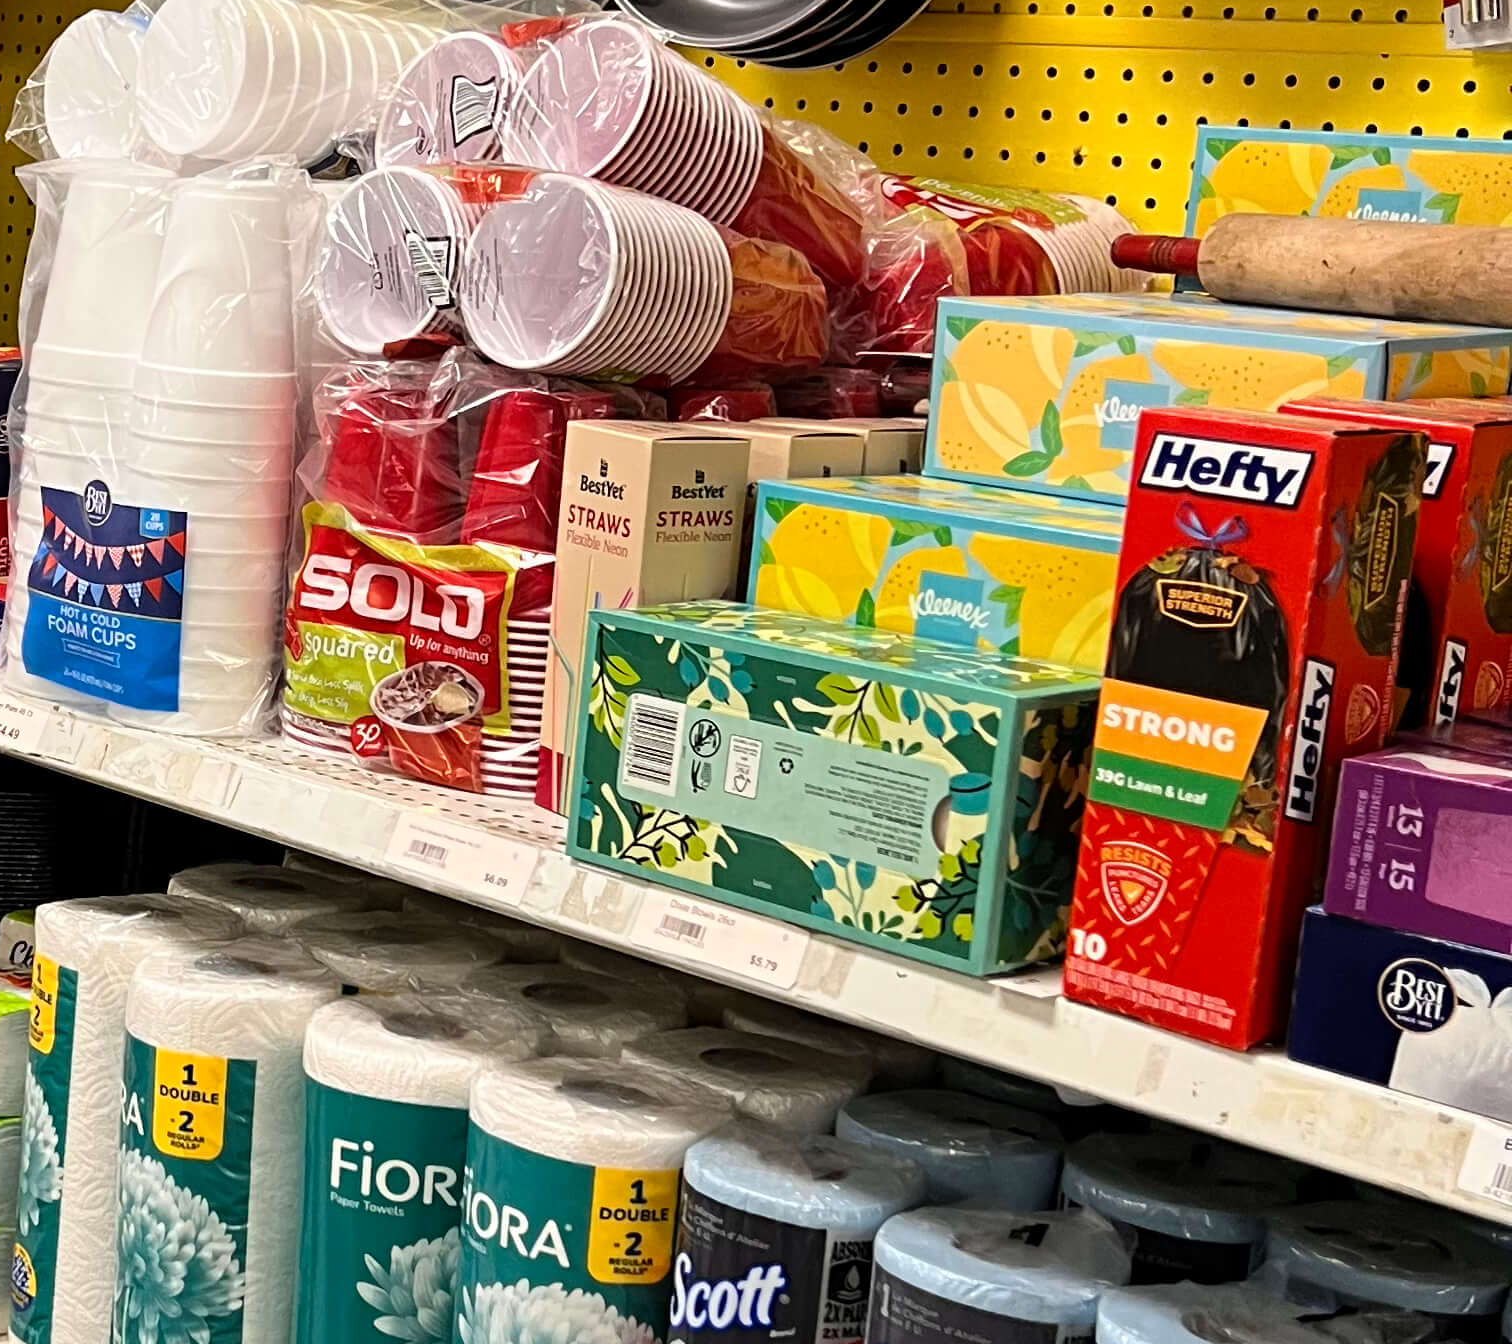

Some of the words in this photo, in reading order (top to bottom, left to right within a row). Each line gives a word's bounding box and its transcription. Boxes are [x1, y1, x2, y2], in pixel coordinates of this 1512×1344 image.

[1151, 440, 1300, 504] Hefty
[580, 474, 625, 501] BestYet
[671, 485, 725, 500] BestYet
[568, 506, 631, 538] STRAWS
[656, 510, 734, 528] STRAWS
[656, 529, 699, 543] Flexible
[703, 531, 731, 543] Neon
[299, 553, 485, 640] SOLO
[909, 588, 991, 629] Kleenex
[1167, 587, 1233, 610] SUPERIOR
[60, 605, 82, 620] HOT
[90, 613, 121, 629] COLD
[1165, 599, 1234, 622] STRENGTH
[48, 615, 88, 639] FOAM
[91, 627, 137, 650] CUPS
[305, 632, 395, 665] squared
[409, 633, 425, 650] Up
[426, 639, 441, 651] for
[443, 644, 489, 665] anything
[355, 724, 381, 751] 30
[1102, 703, 1236, 752] STRONG
[1290, 664, 1335, 816] Hefty
[1095, 768, 1126, 787] 39G
[1128, 775, 1161, 796] Lawn
[1165, 785, 1176, 798] &
[1179, 787, 1207, 806] Leaf
[1101, 846, 1172, 878] RESISTS
[1071, 928, 1107, 961] 10
[750, 954, 778, 972] $5.79
[1387, 968, 1447, 1014] BEST
[182, 1064, 197, 1086] 1
[160, 1084, 219, 1107] DOUBLE
[178, 1111, 195, 1133] 2
[330, 1192, 361, 1209] Paper
[363, 1200, 405, 1217] Towels
[630, 1181, 646, 1204] 1
[599, 1204, 670, 1223] DOUBLE
[625, 1233, 643, 1256] 2
[671, 1253, 786, 1329] Scott
